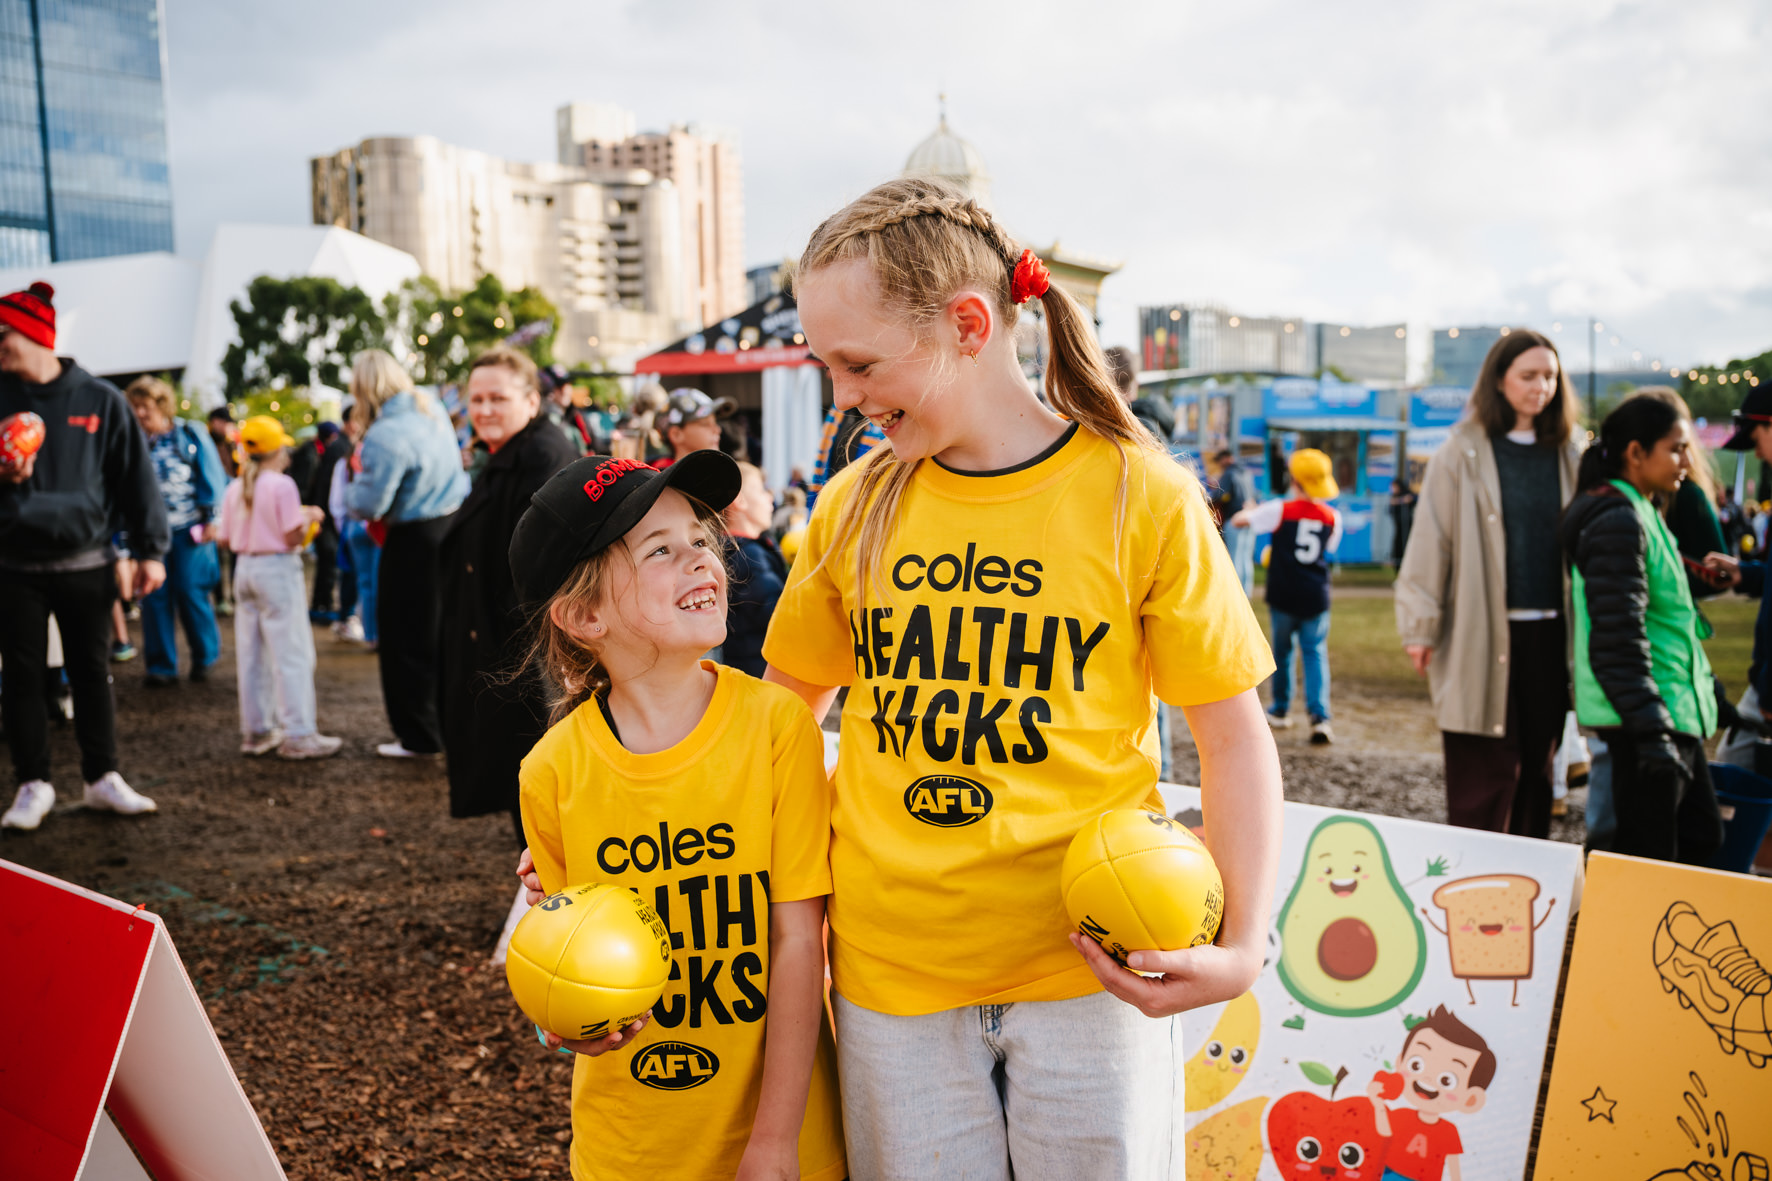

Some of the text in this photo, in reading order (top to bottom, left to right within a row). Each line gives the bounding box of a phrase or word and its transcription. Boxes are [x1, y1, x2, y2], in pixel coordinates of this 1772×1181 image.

[1294, 517, 1323, 564] 5
[892, 542, 1043, 597] coles
[850, 604, 1111, 692] HEALTHY
[870, 685, 1052, 765] KICKS
[910, 787, 986, 814] AFL
[597, 821, 735, 875] coles
[650, 951, 767, 1028] CKS
[638, 1053, 714, 1079] AFL
[1405, 1132, 1428, 1159] A
